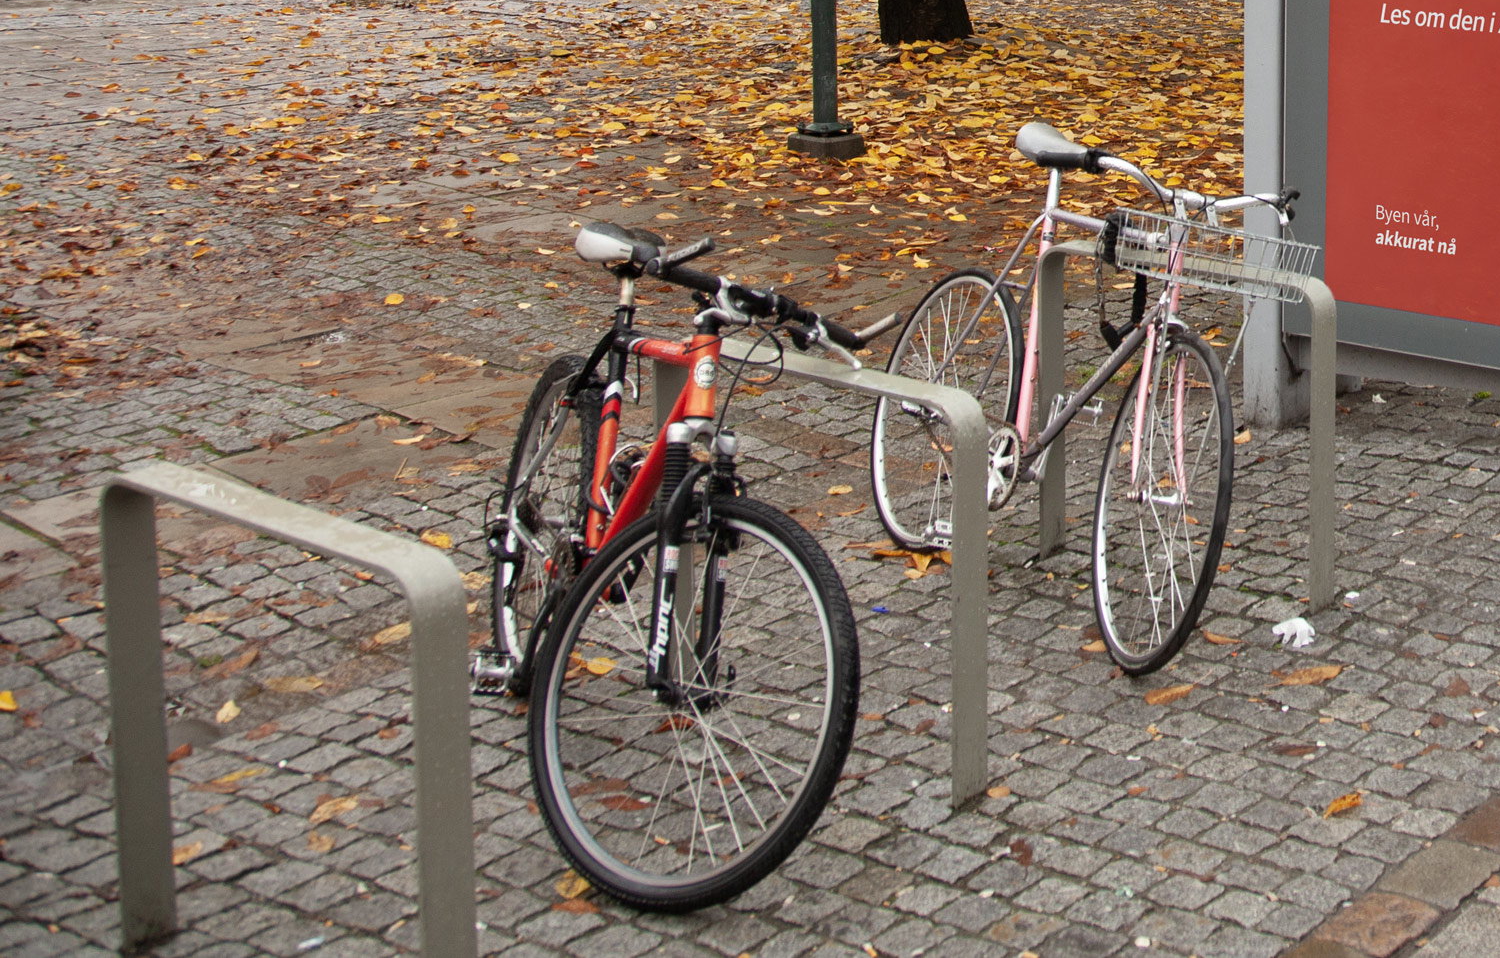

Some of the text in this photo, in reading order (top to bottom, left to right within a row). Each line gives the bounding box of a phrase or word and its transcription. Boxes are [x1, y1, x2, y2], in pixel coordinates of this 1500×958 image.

[1380, 3, 1411, 26] Les
[1415, 10, 1445, 29] om
[1449, 8, 1485, 32] den
[1489, 12, 1496, 33] i
[1375, 204, 1440, 231] Byen vår,
[1375, 230, 1457, 255] akkurat nå
